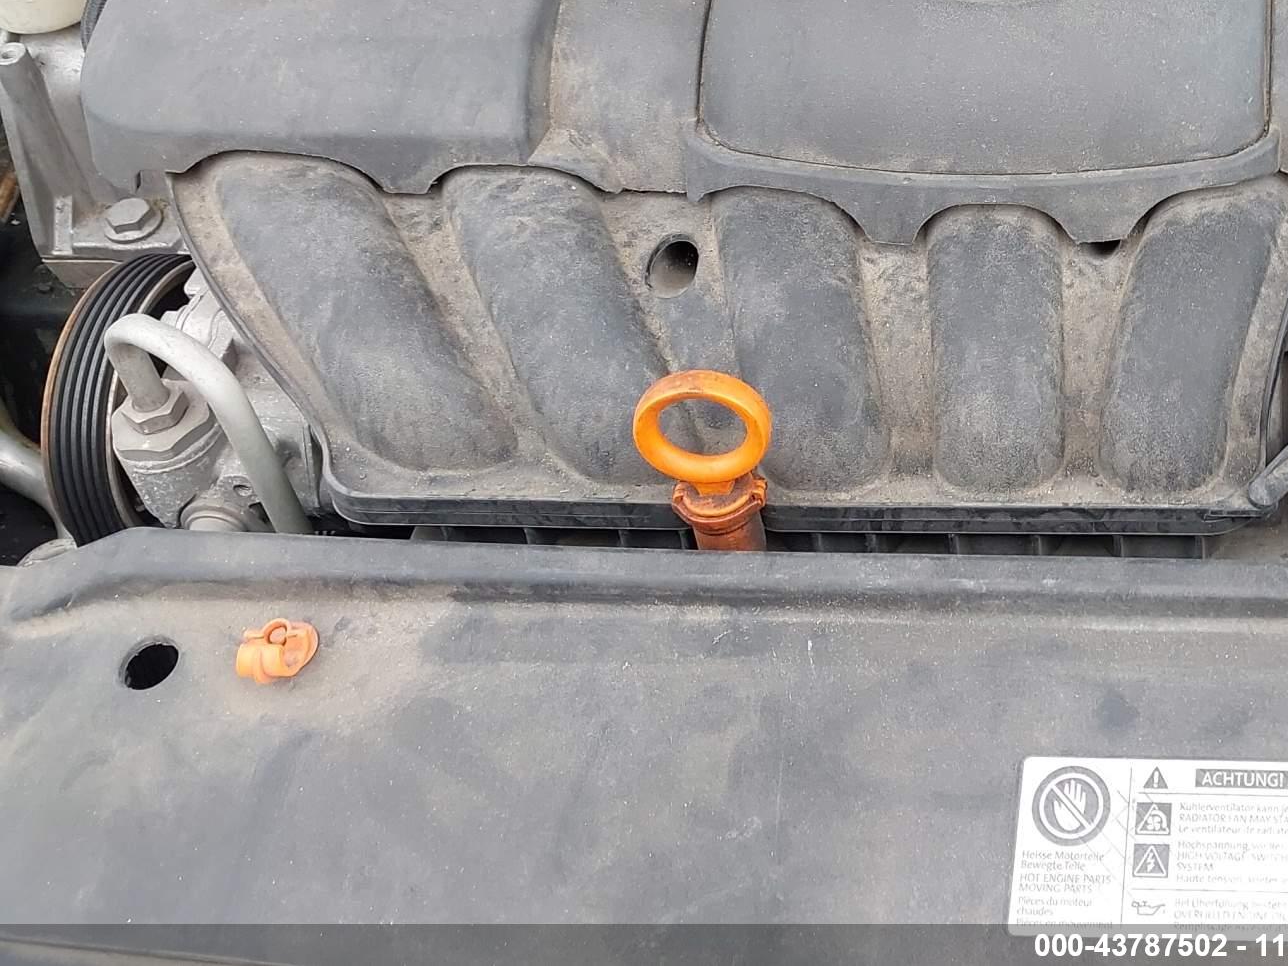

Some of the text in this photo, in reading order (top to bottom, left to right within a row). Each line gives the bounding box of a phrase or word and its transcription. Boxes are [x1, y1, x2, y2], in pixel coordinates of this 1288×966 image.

[1201, 770, 1284, 788] ACHTUNG!
[1179, 813, 1226, 823] RADIATOR
[1249, 815, 1271, 824] MAY
[1178, 825, 1189, 834] Le
[1022, 850, 1105, 863] Heisse Motorteile
[1177, 851, 1203, 861] HIGH
[1020, 860, 1087, 872] Bewegte Teile
[1177, 862, 1215, 872] SYSTEM
[1020, 873, 1112, 885] HOT ENGINE PARTS
[1176, 874, 1205, 884] Haute
[1018, 883, 1093, 894] MOVING PARTS
[1046, 896, 1058, 906] du
[1016, 906, 1054, 916] chaudes
